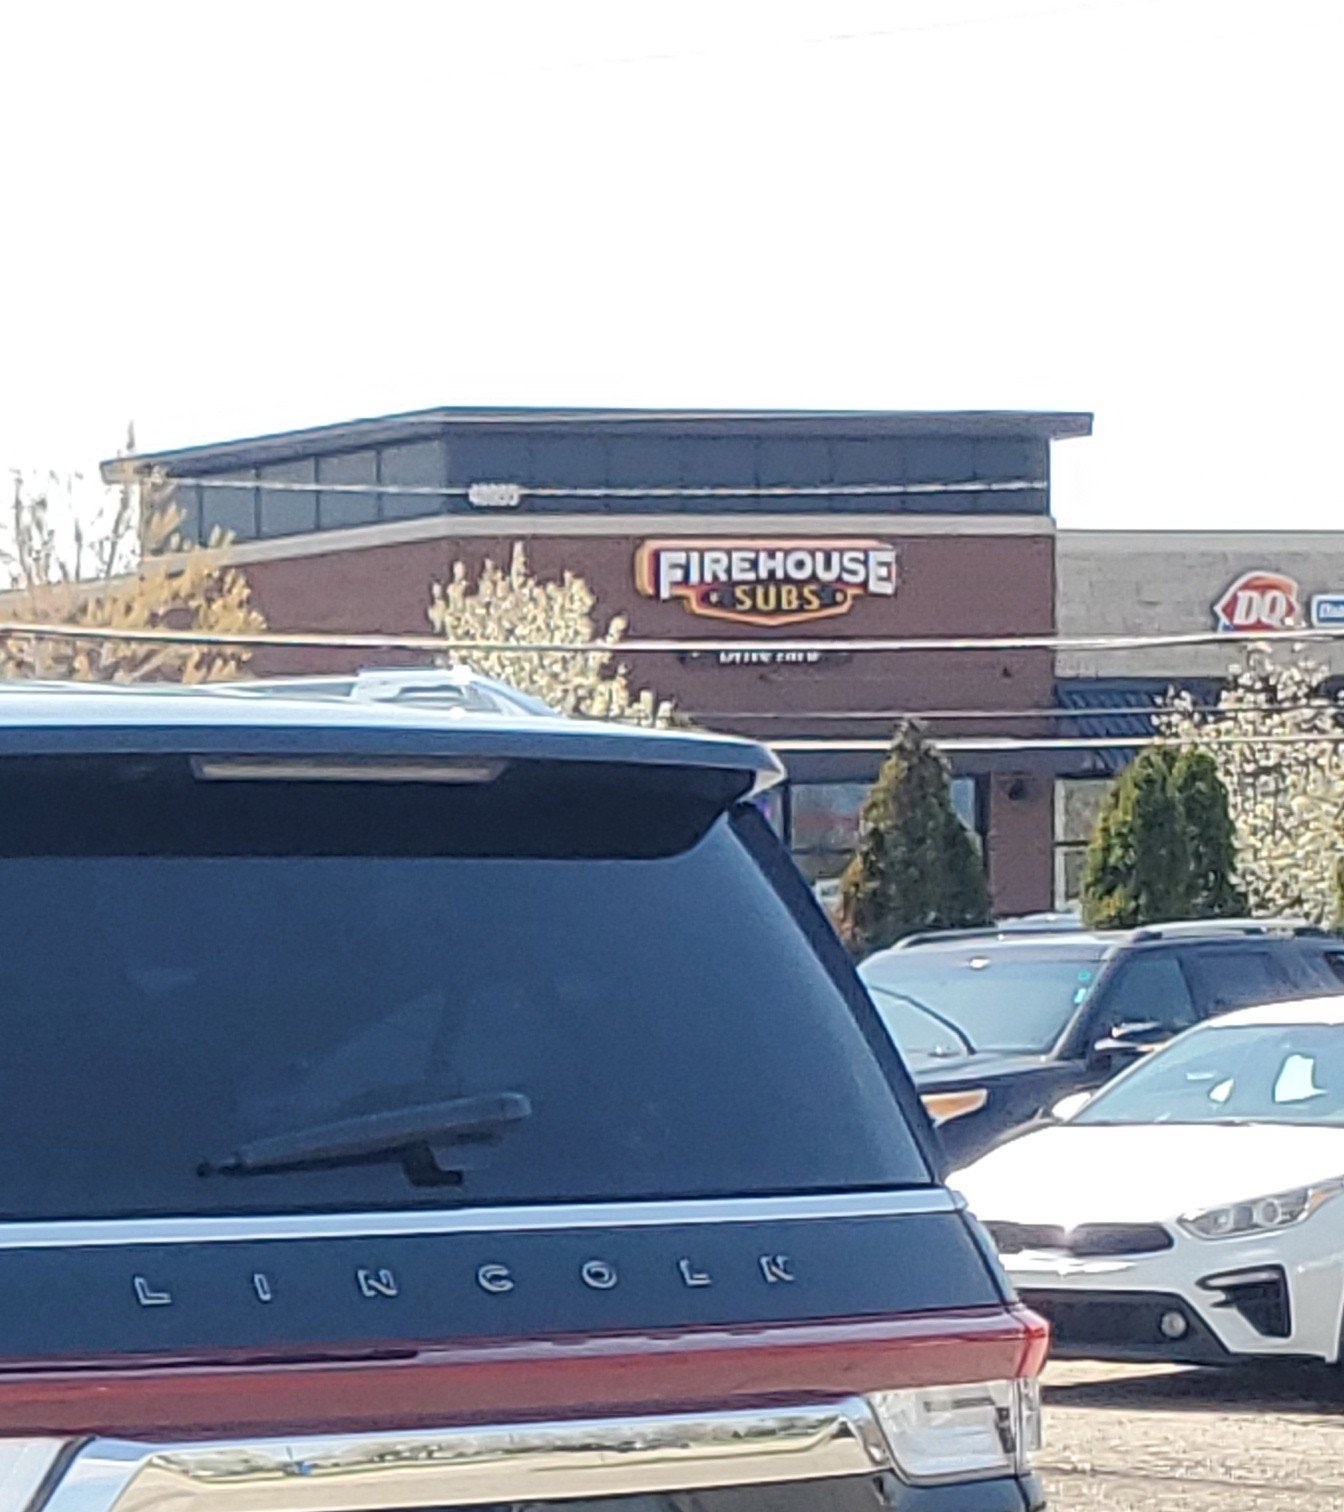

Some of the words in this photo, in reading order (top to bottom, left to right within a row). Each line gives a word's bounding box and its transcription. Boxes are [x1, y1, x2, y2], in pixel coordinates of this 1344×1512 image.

[658, 551, 896, 600] FIREHOUSE
[734, 585, 821, 611] SUBS
[1234, 589, 1287, 627] DQ
[134, 1255, 795, 1306] LINCOLN
